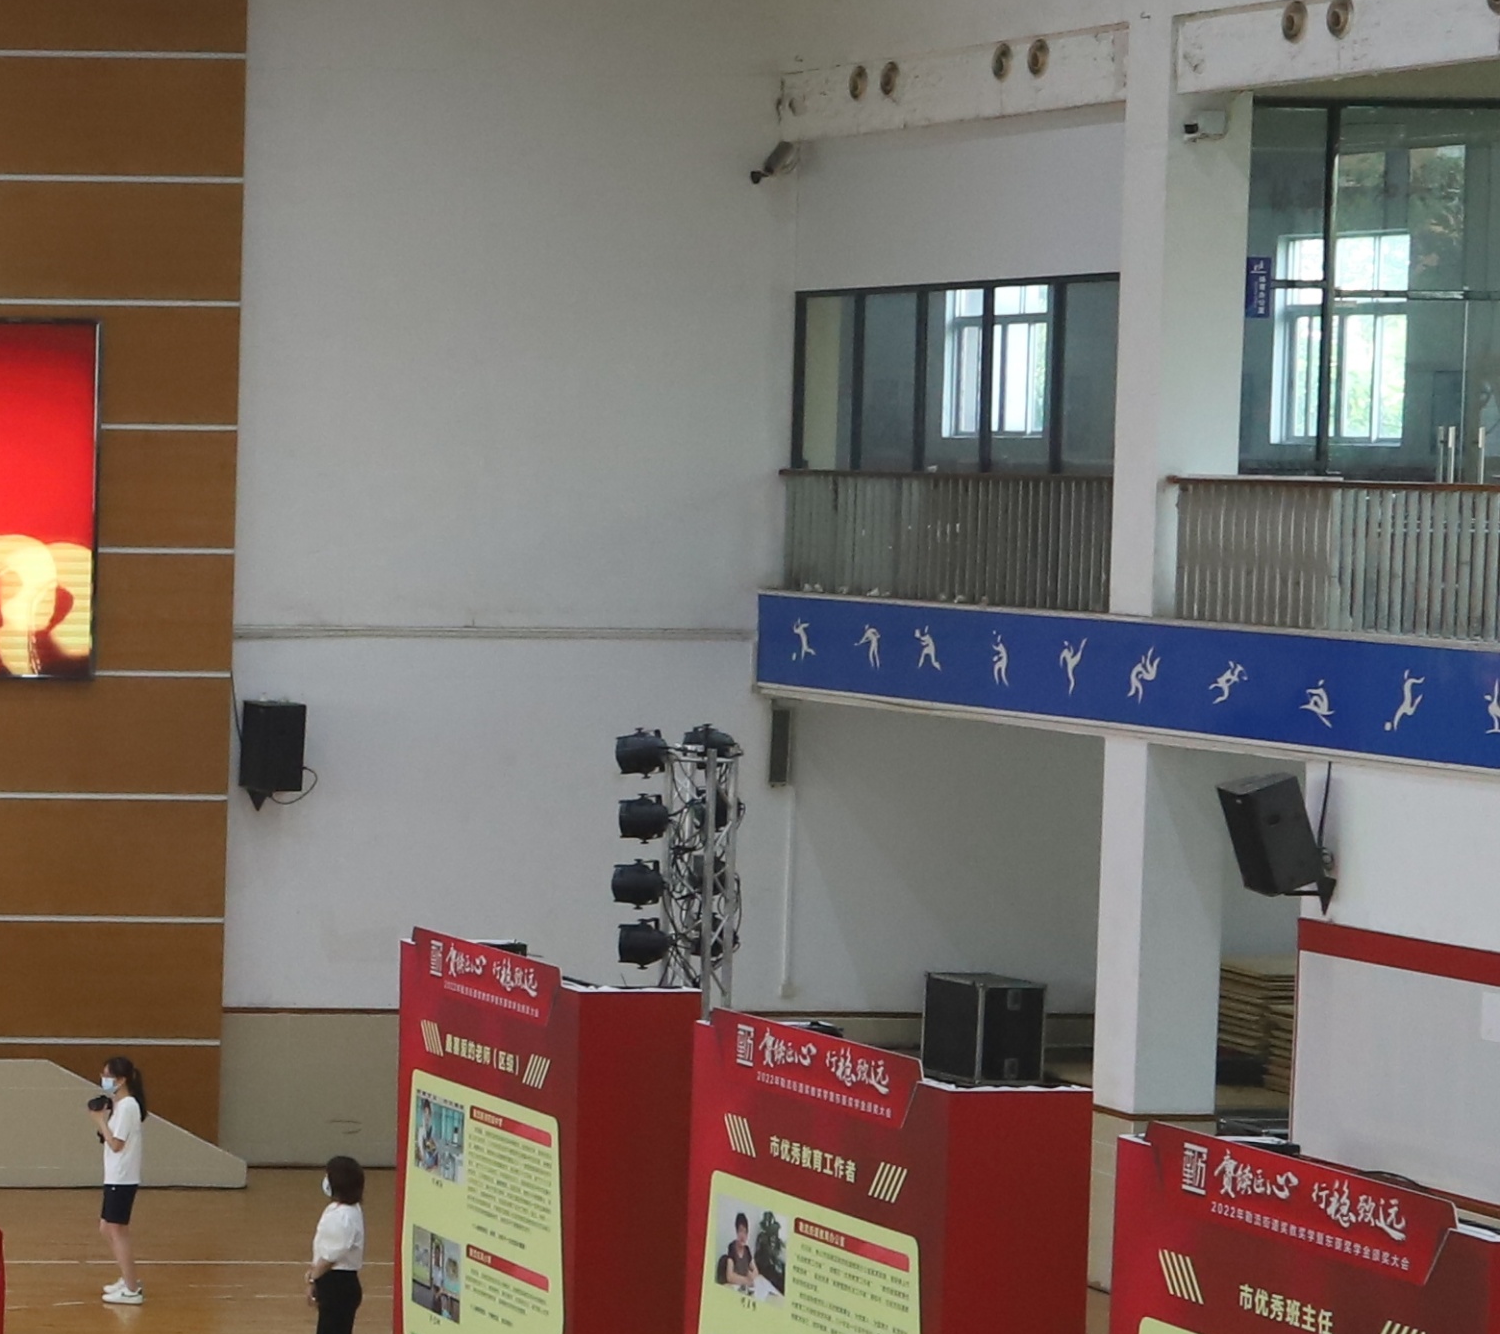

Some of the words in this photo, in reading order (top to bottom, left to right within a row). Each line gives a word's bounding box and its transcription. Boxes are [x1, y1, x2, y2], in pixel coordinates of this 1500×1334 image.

[769, 1135, 856, 1184] 市优秀教育工作者
